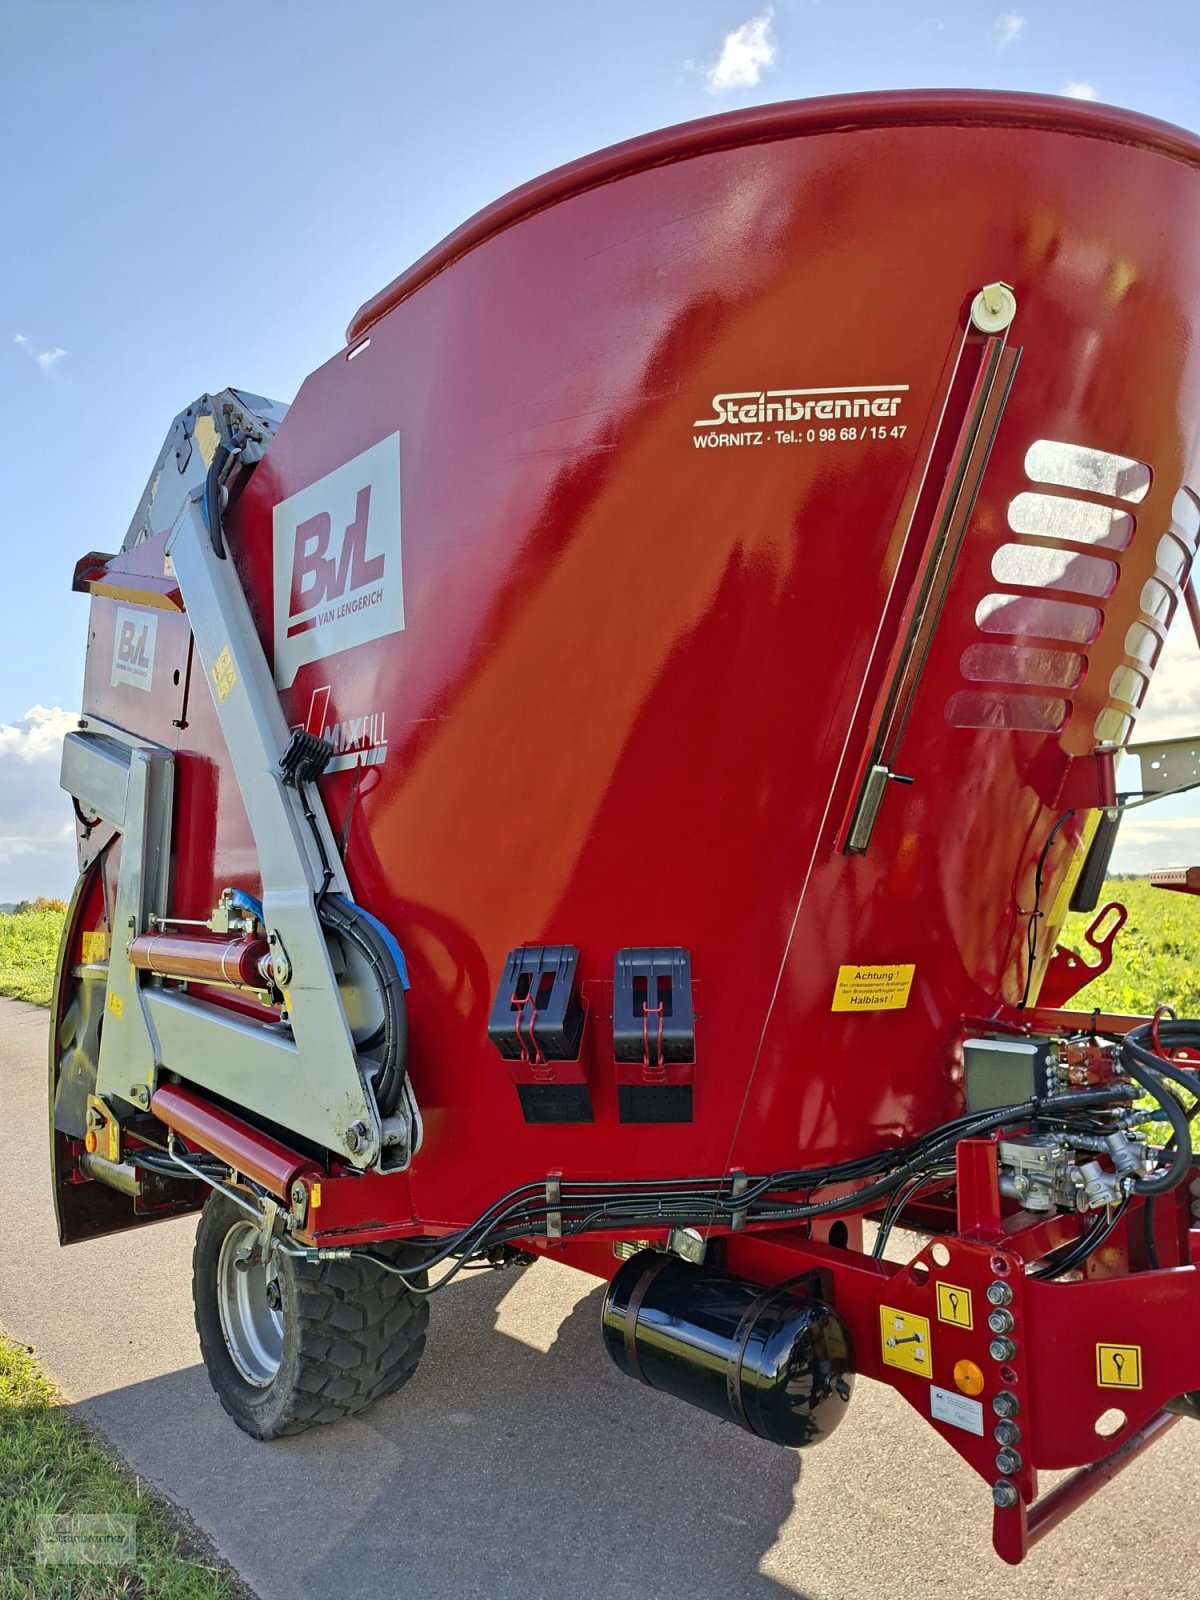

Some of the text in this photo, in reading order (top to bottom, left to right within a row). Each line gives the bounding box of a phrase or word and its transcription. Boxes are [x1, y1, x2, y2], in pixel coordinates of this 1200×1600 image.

[693, 386, 904, 427] Steinbrenner
[693, 431, 763, 449] WÖRNITZ
[775, 430, 803, 445] Tel.:
[806, 429, 815, 442] 0
[819, 428, 836, 442] 98
[840, 427, 857, 441] 68
[871, 426, 887, 439] 15
[890, 425, 907, 439] 47
[317, 588, 383, 626] VAN LENGERICH
[854, 971, 894, 981] Achtung
[850, 995, 888, 1005] Halblast
